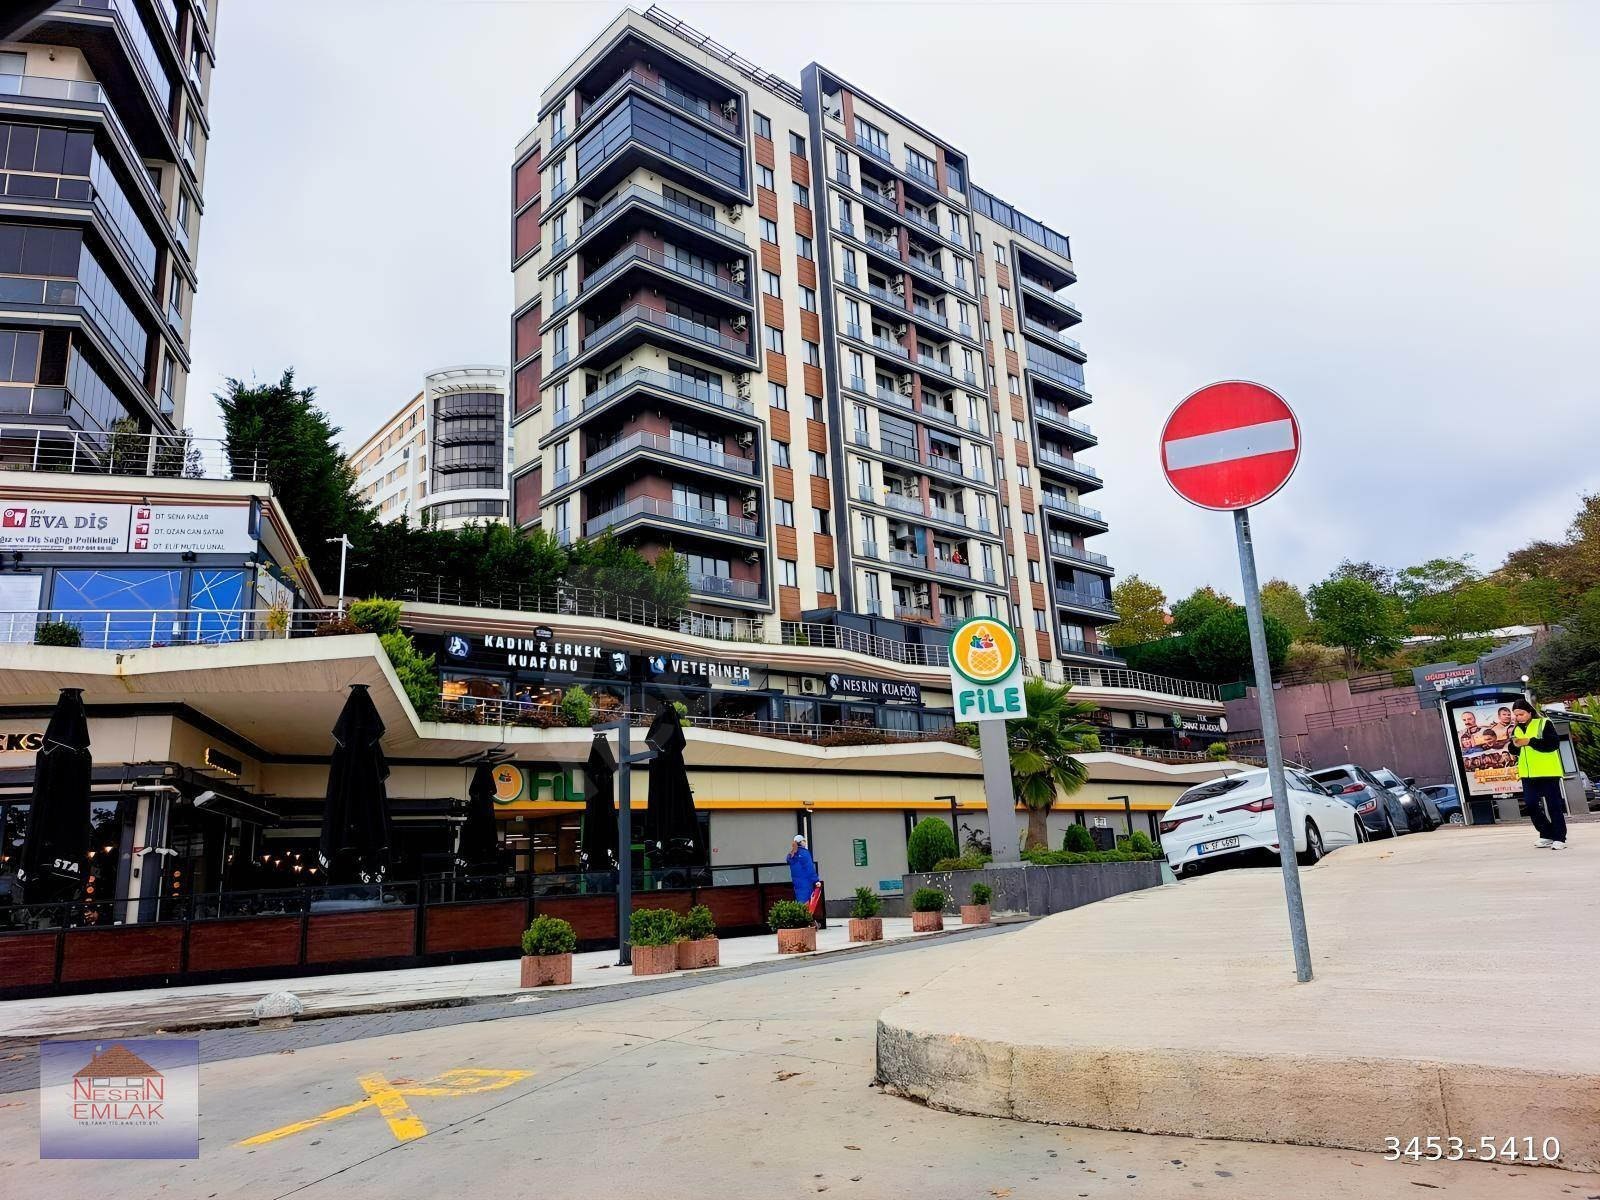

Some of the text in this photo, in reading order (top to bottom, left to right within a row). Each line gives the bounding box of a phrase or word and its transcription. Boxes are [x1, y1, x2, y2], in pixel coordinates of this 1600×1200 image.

[29, 513, 108, 530] EVA DİŞ
[484, 634, 602, 658] KADIN & ERKEK
[508, 654, 578, 672] KUAFÖRÜ
[671, 660, 750, 680] VETERİNER
[842, 679, 879, 693] NESRİN
